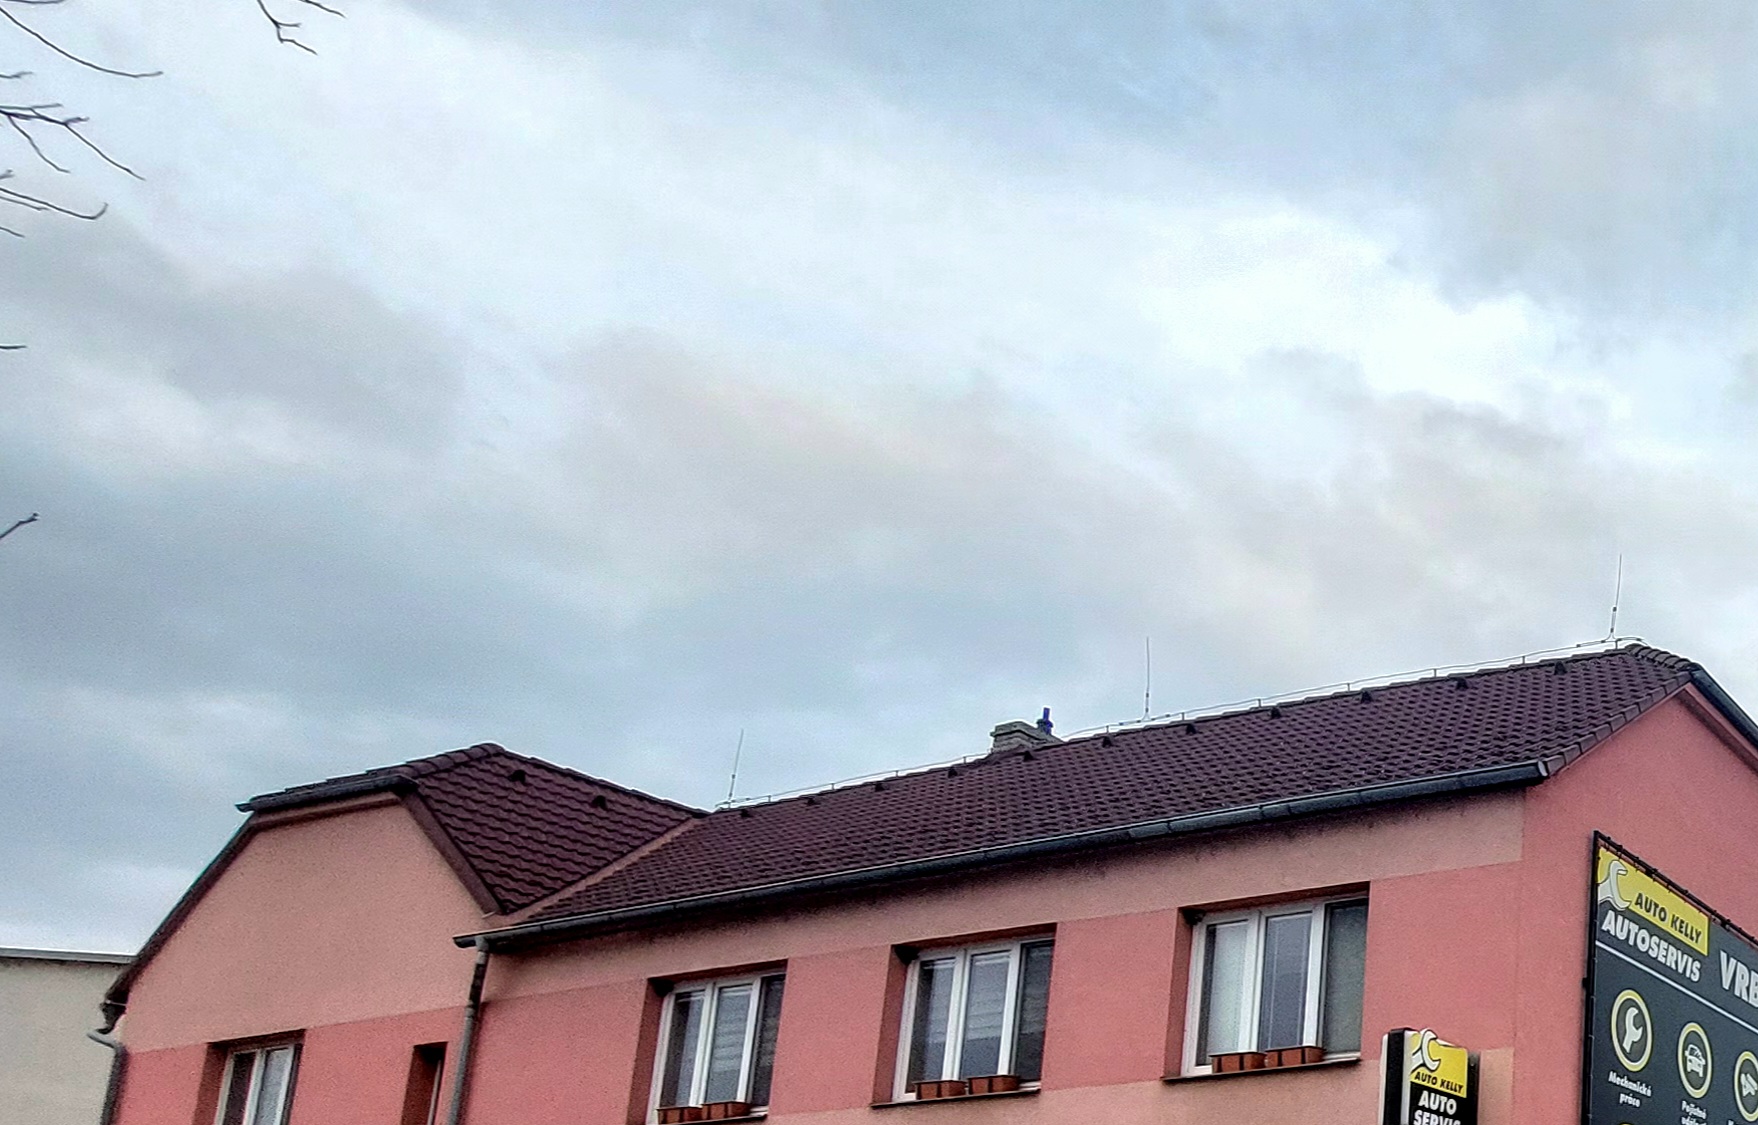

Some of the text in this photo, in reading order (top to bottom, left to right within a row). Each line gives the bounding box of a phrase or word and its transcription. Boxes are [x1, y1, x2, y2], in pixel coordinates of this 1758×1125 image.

[1634, 892, 1702, 944] AUTO KELLY
[1601, 909, 1701, 982] AUTOSERVIS
[1414, 1071, 1464, 1094] AUTO KELLY
[1418, 1090, 1457, 1115] AUTO
